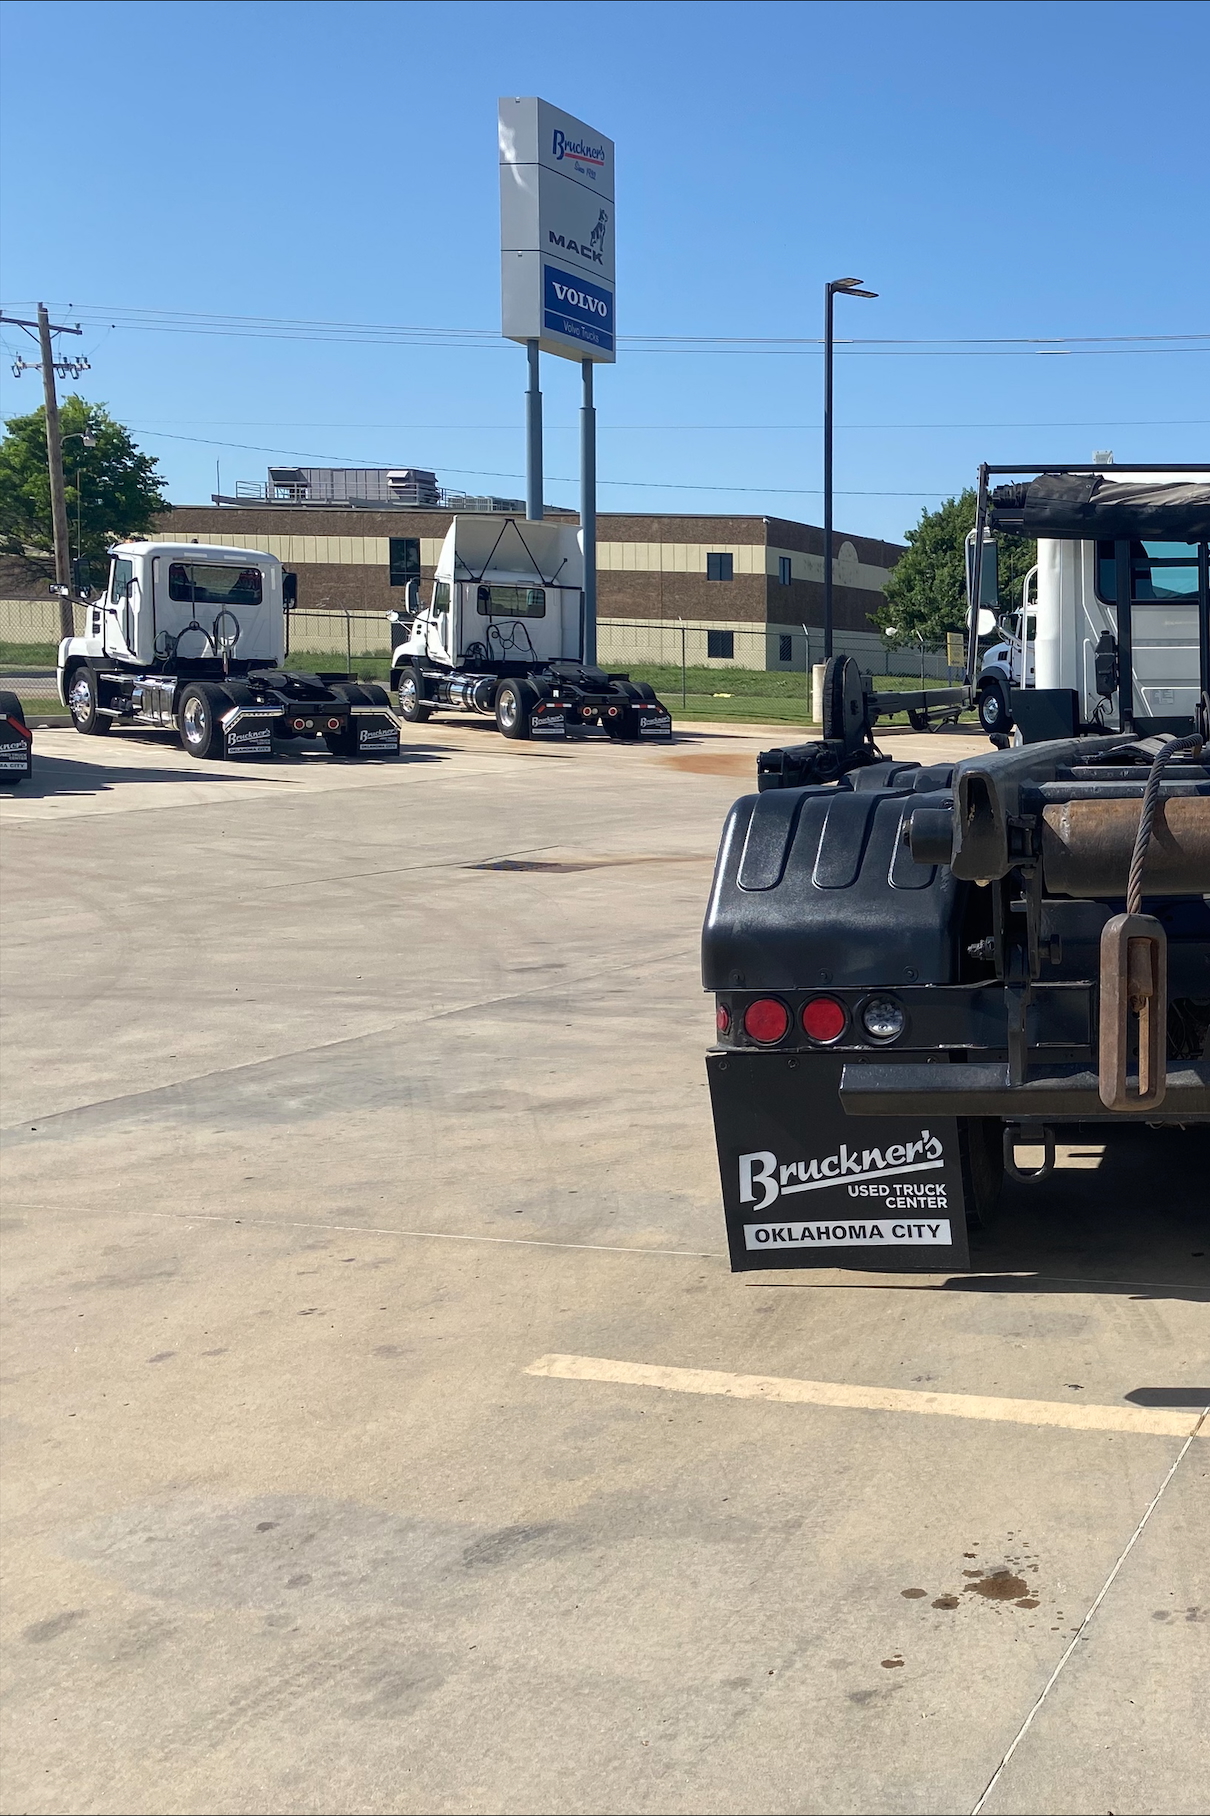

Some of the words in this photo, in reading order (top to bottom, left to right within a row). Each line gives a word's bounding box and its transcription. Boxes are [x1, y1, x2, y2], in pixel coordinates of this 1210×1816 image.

[552, 129, 605, 161] Bruckner's
[549, 231, 603, 266] MACK
[552, 281, 607, 317] VOLVO
[563, 319, 580, 336] Volvo
[581, 326, 600, 344] Trucks
[738, 1130, 944, 1212] Bruckner's
[848, 1184, 890, 1197] USED
[893, 1184, 947, 1196] TRUCK
[885, 1197, 948, 1209] CENTER
[754, 1224, 885, 1243] OKLAHOMA
[891, 1224, 941, 1239] CITY
